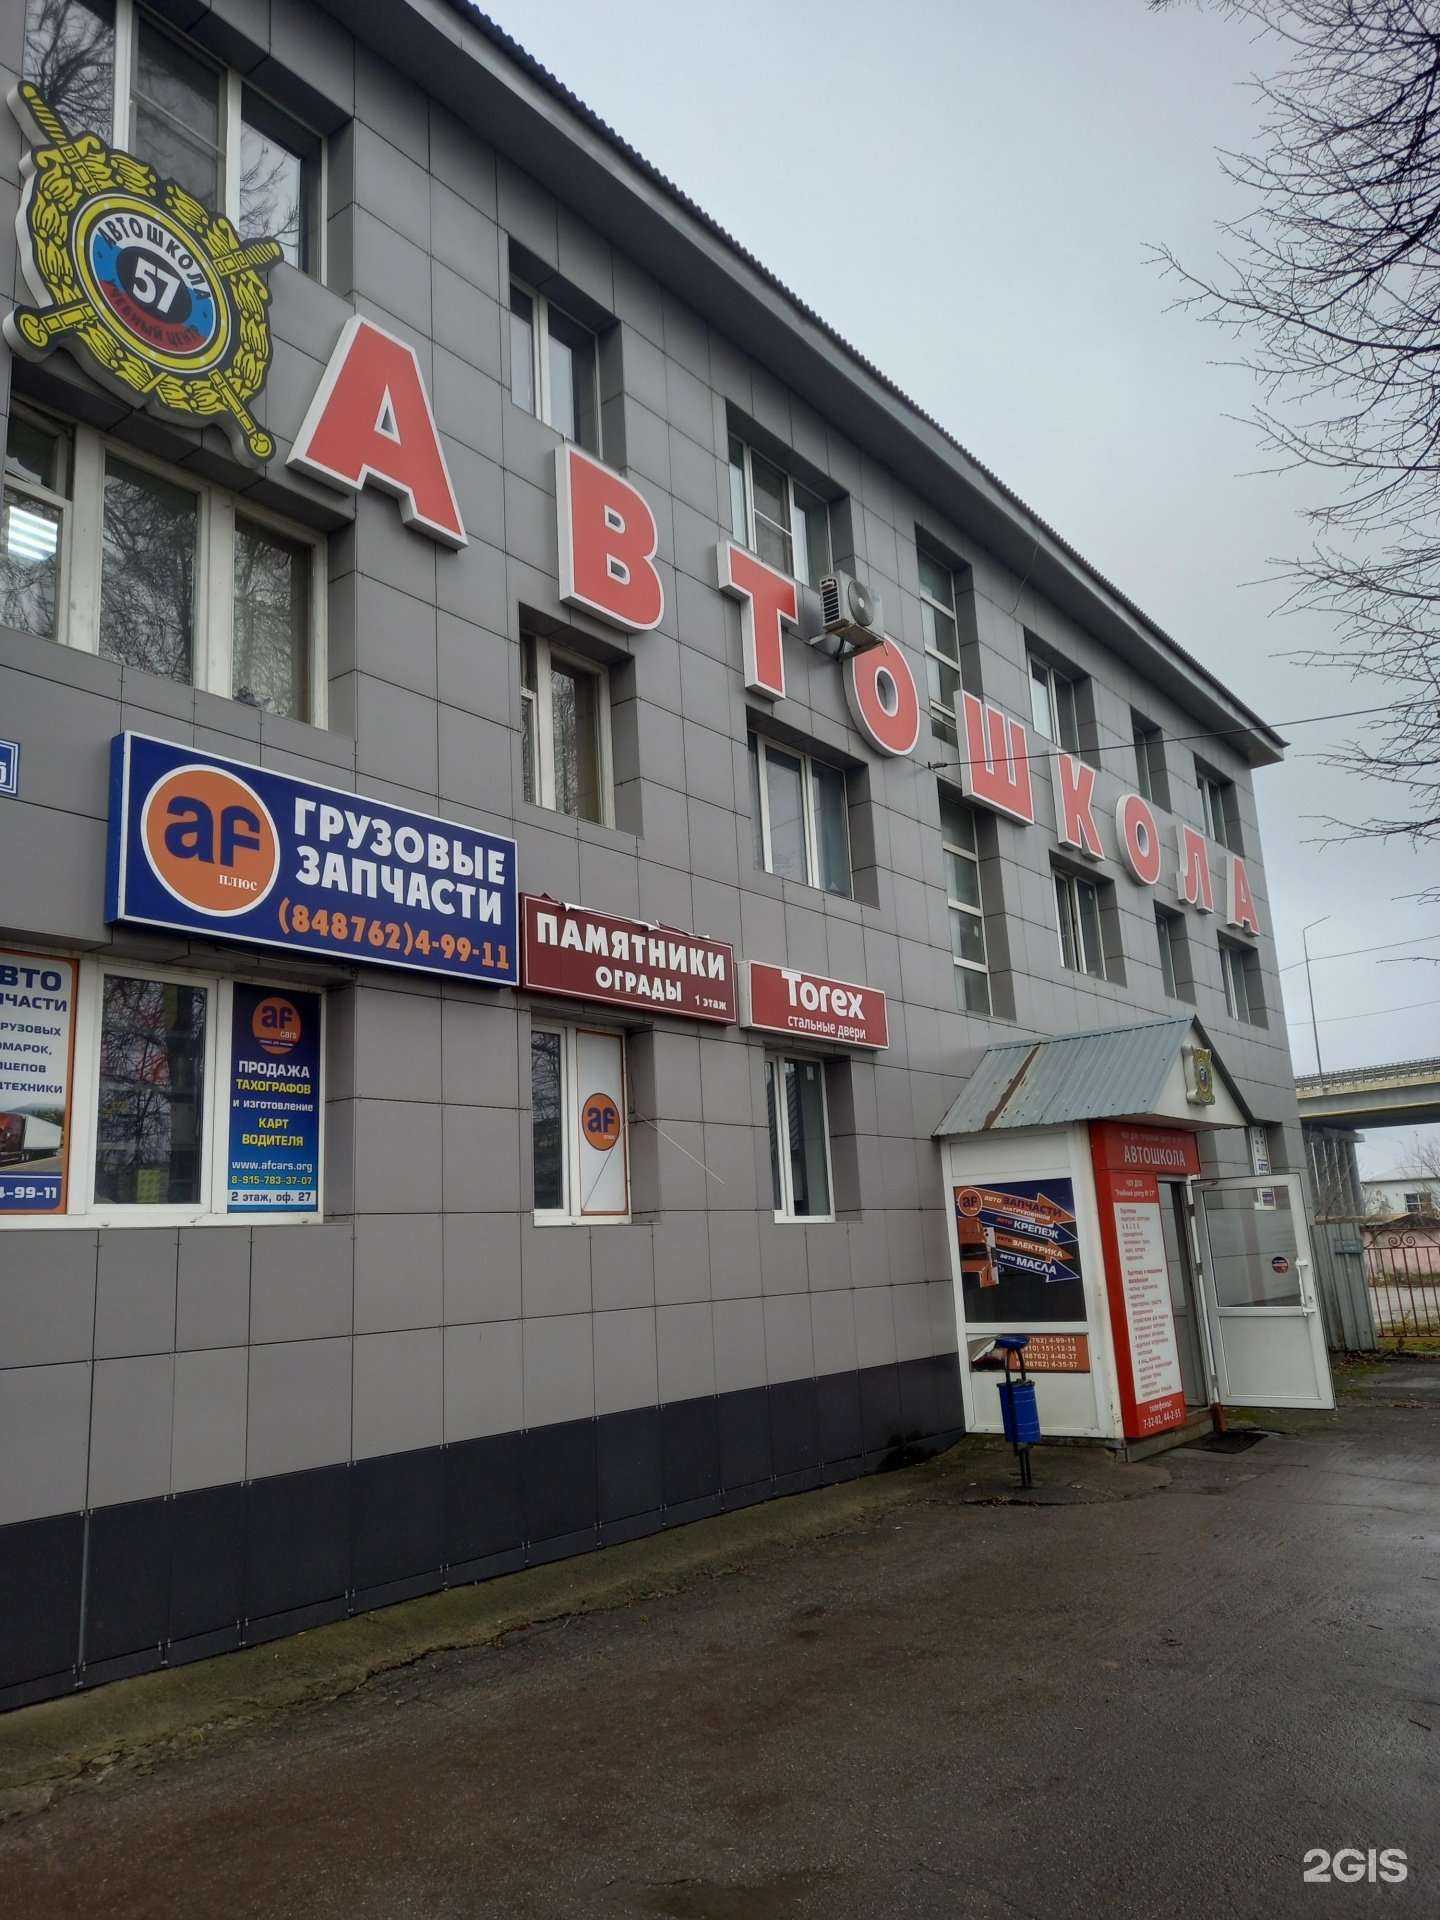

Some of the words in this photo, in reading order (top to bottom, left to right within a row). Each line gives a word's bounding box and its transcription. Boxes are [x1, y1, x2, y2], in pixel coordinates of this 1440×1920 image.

[98, 217, 211, 299] АВТОШКОЛА
[133, 257, 180, 313] 57
[294, 797, 505, 885] ГРУЗОВЫЕ
[295, 845, 502, 925] ЗАПЧАСТИ
[278, 897, 510, 970] (848762)4-99-11
[537, 912, 725, 981] ПАМЯТНИКИ
[595, 966, 682, 1002] ОГРАДЫ
[694, 994, 700, 1006] 1
[702, 997, 727, 1011] этаж
[781, 969, 866, 1020] Torex
[787, 1015, 836, 1034] стальные
[837, 1025, 866, 1042] двери
[238, 1060, 310, 1078] ПРОДАЖА
[235, 1079, 311, 1094] ТАХОГРАФОВ
[232, 1100, 240, 1108] и
[243, 1100, 313, 1112] изготовление
[258, 1118, 289, 1129] КАРТ
[242, 1133, 304, 1147] ВОДИТЕЛЯ
[1124, 1144, 1186, 1168] АВТОШКОЛА
[232, 1161, 312, 1173] www.afcars.org
[231, 1176, 312, 1185] 8-915-783-37-07
[231, 1191, 239, 1201] 2
[243, 1194, 271, 1203] этаж,
[276, 1192, 293, 1203] оф.
[298, 1191, 311, 1201] 27
[1003, 1195, 1062, 1217] ЗАПЧАСТИ
[1013, 1220, 1060, 1239] КРЕПЕЖ
[1012, 1239, 1063, 1257] ЭЛЕКТРИКА
[1016, 1256, 1057, 1275] МАСЛА
